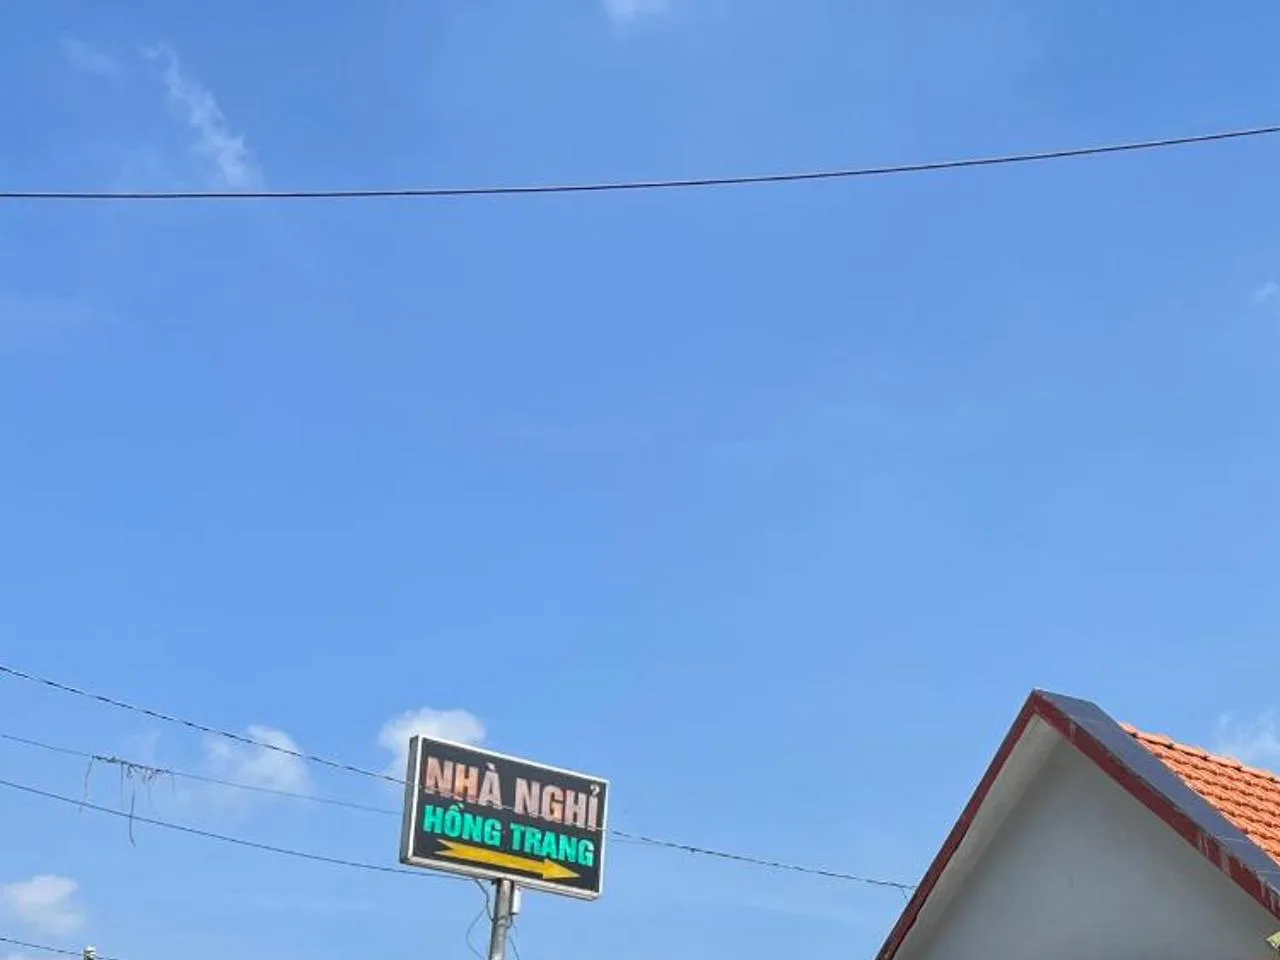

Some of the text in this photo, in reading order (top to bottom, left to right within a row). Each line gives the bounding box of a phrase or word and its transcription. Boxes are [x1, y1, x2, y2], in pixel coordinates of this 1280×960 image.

[425, 757, 599, 831] NHÀ NGHỈ
[424, 803, 595, 867] HỒNG TRANG
